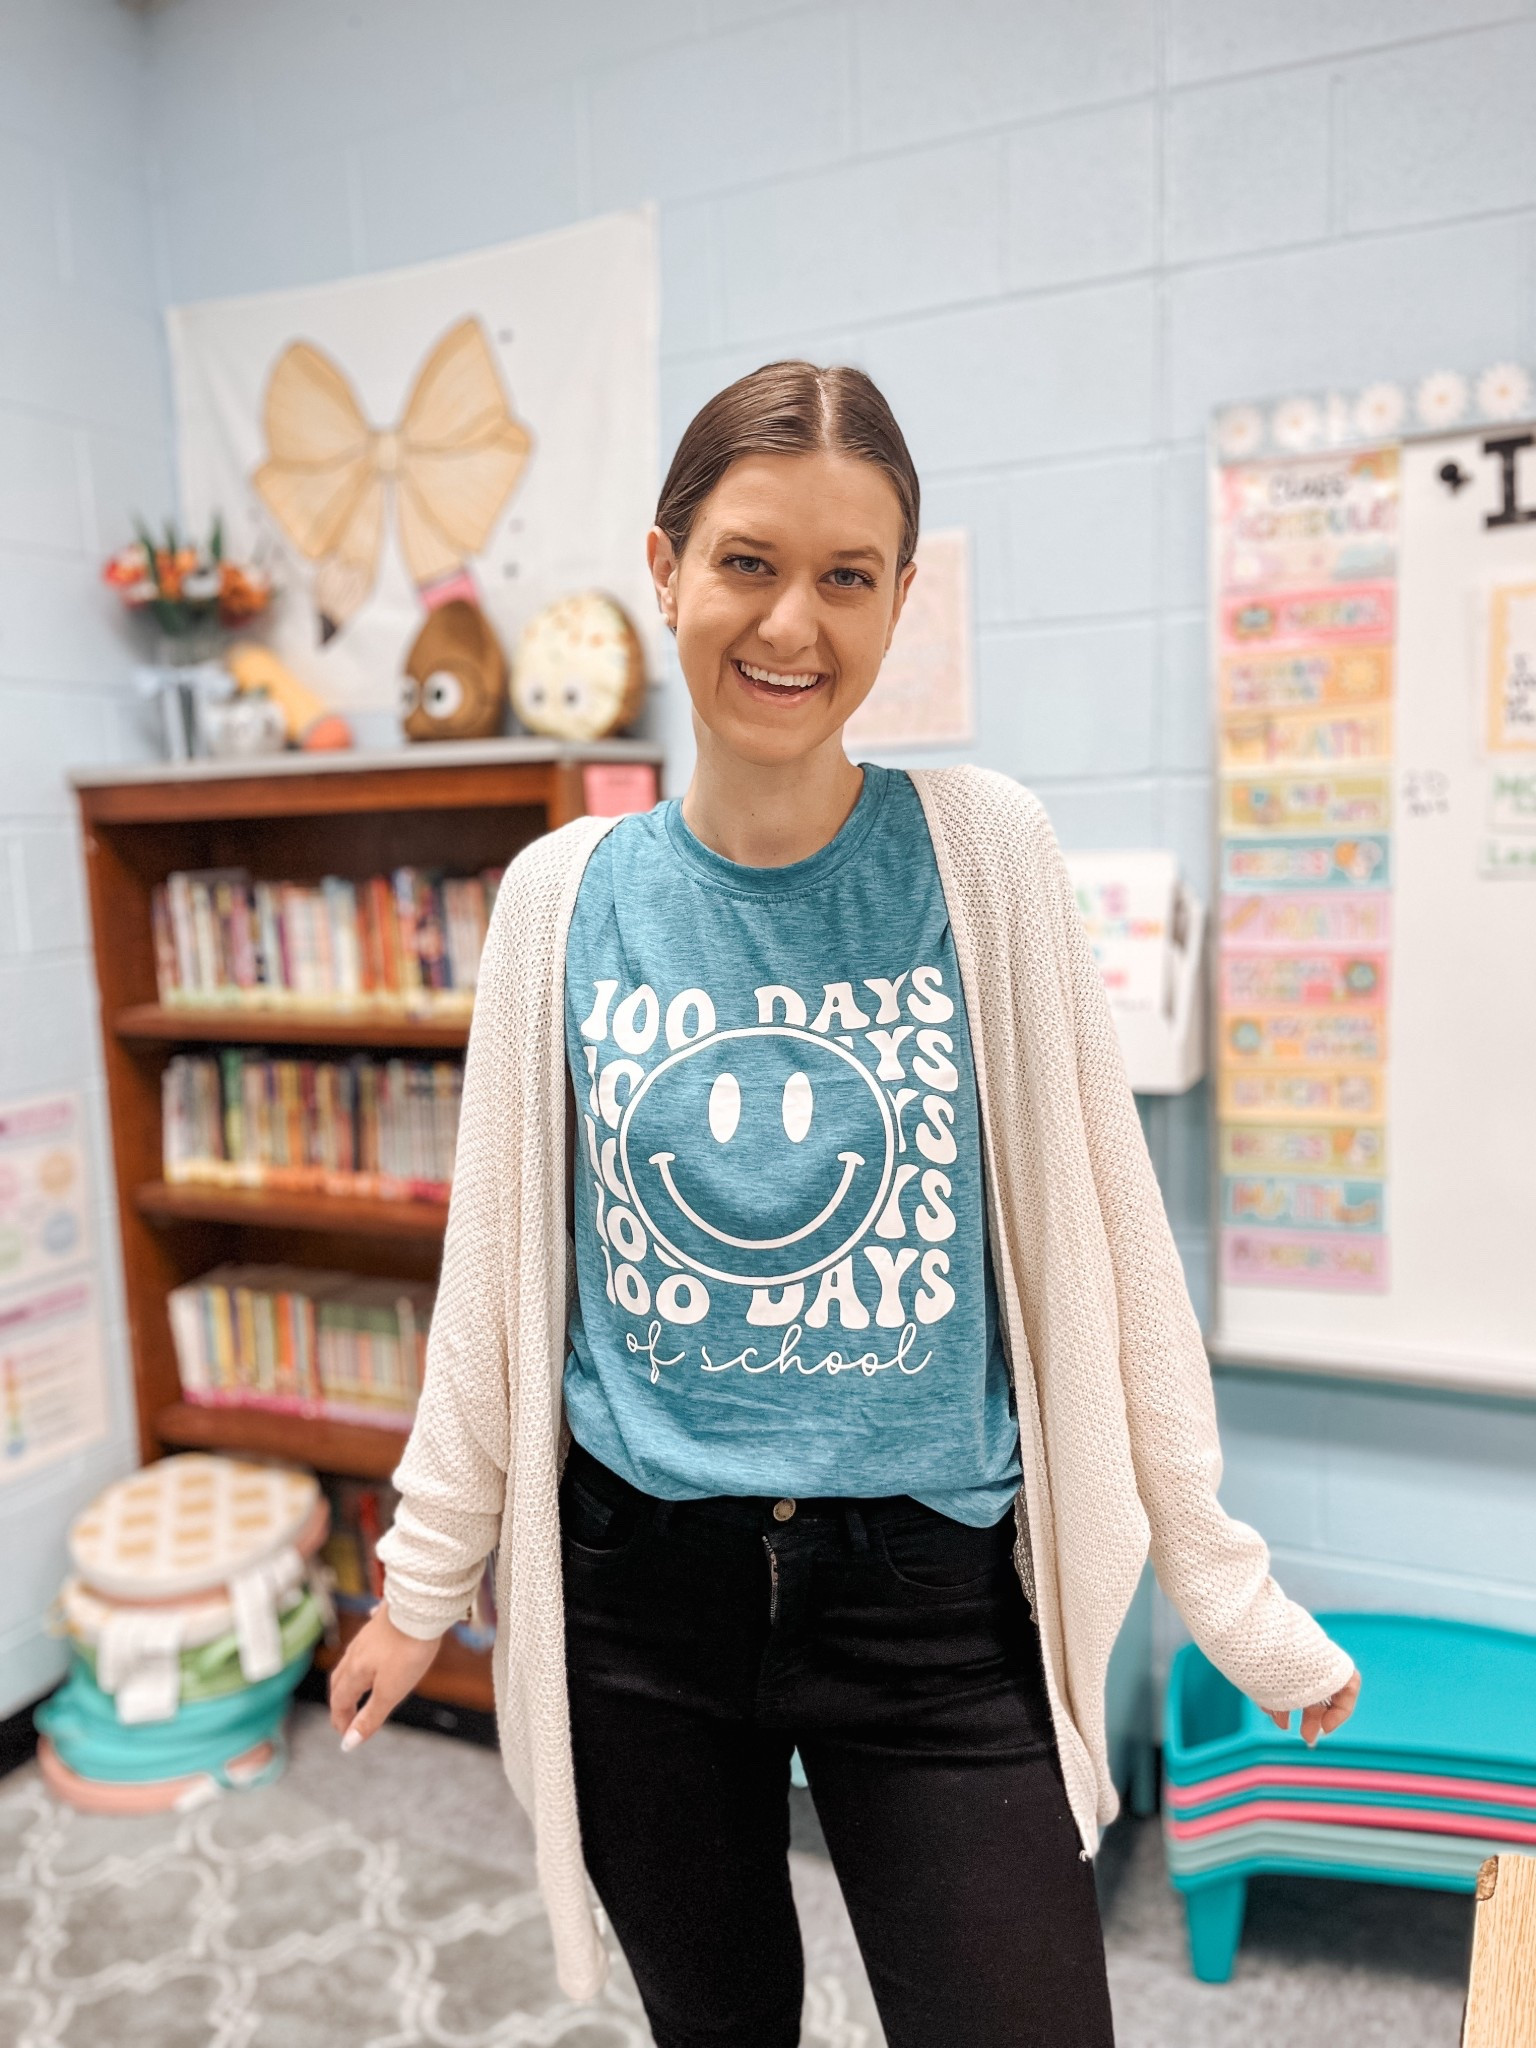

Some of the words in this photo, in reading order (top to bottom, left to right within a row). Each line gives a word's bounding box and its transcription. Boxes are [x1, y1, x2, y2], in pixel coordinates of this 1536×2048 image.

[581, 979, 716, 1055] 100
[626, 1320, 686, 1384] of
[700, 1322, 933, 1377] school
